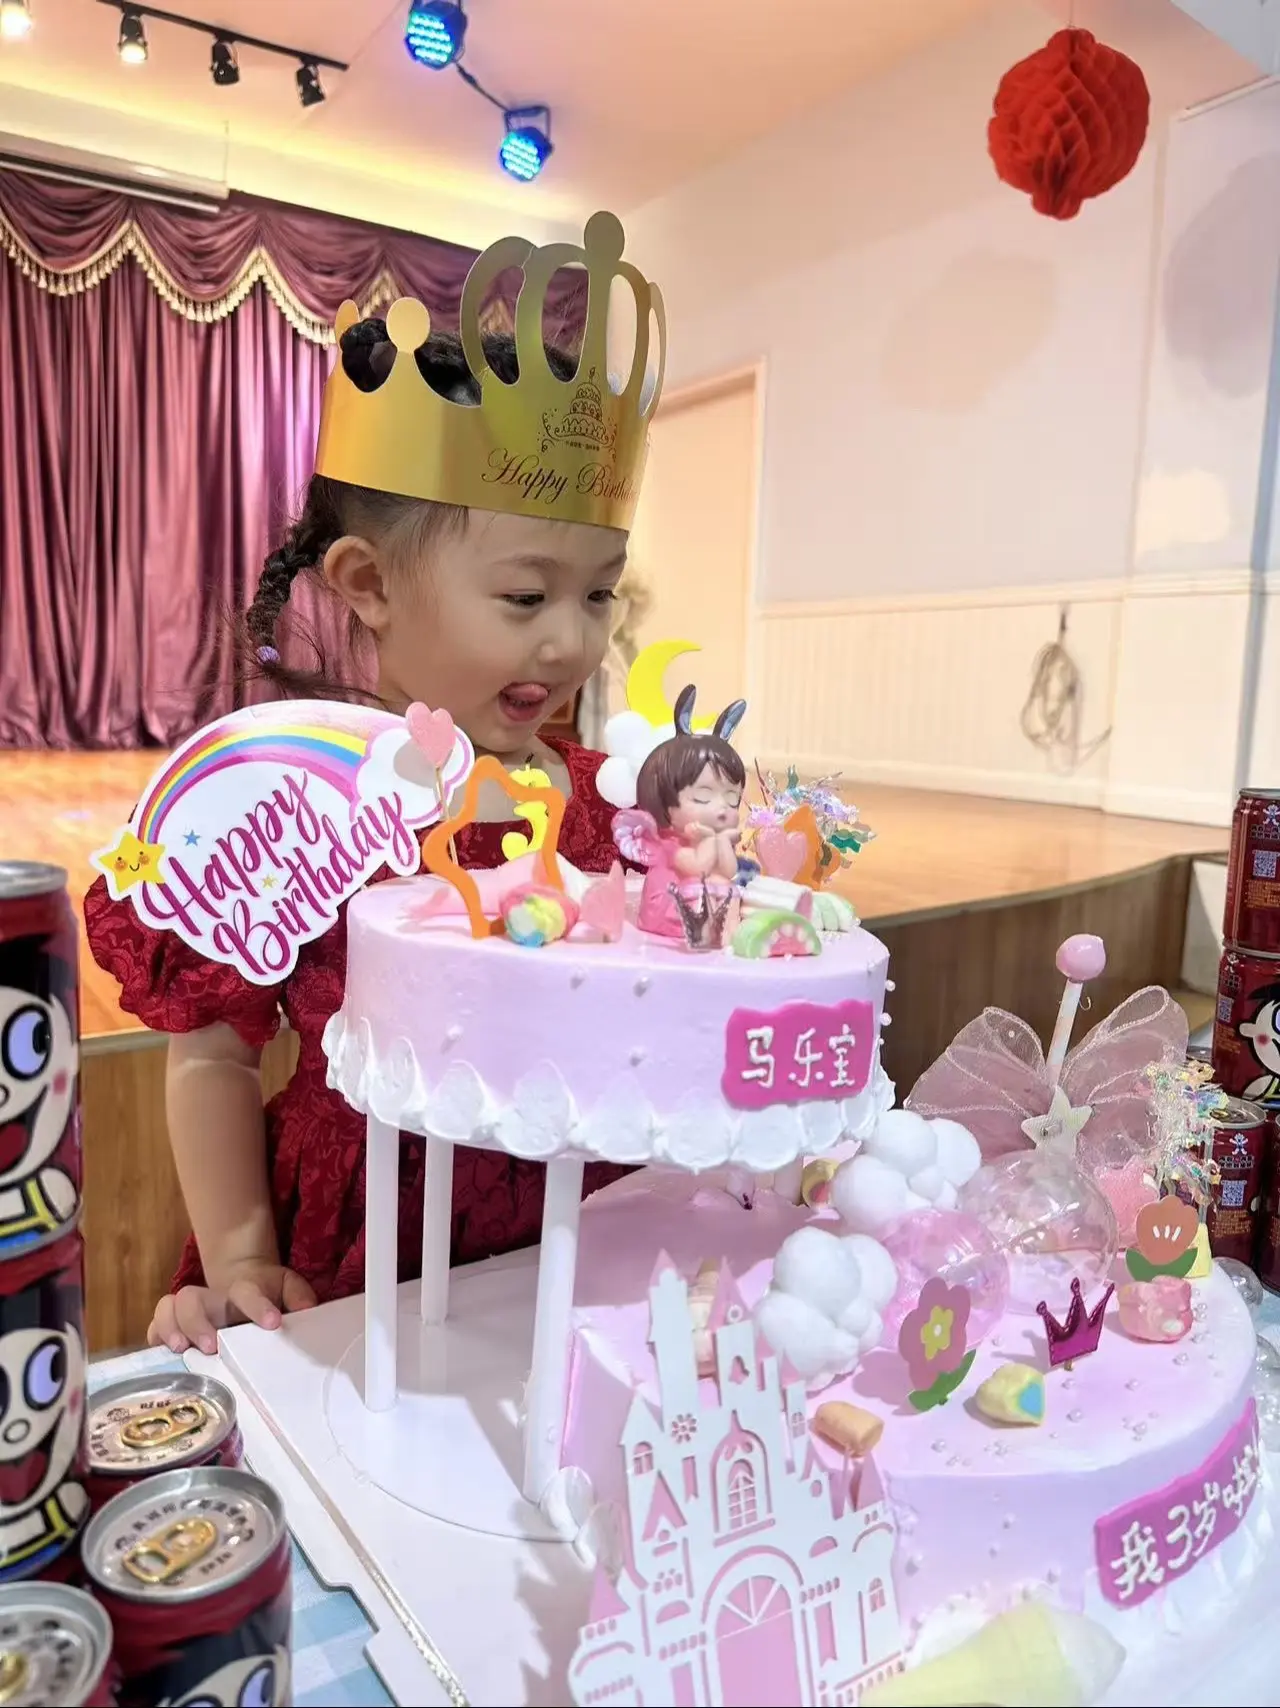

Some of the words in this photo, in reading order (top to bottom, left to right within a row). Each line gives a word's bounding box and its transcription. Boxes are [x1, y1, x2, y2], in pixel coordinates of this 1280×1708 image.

[481, 448, 568, 504] Happy
[142, 770, 320, 936] Happy
[213, 791, 415, 975] Birthday
[741, 1023, 855, 1089] 马乐宝
